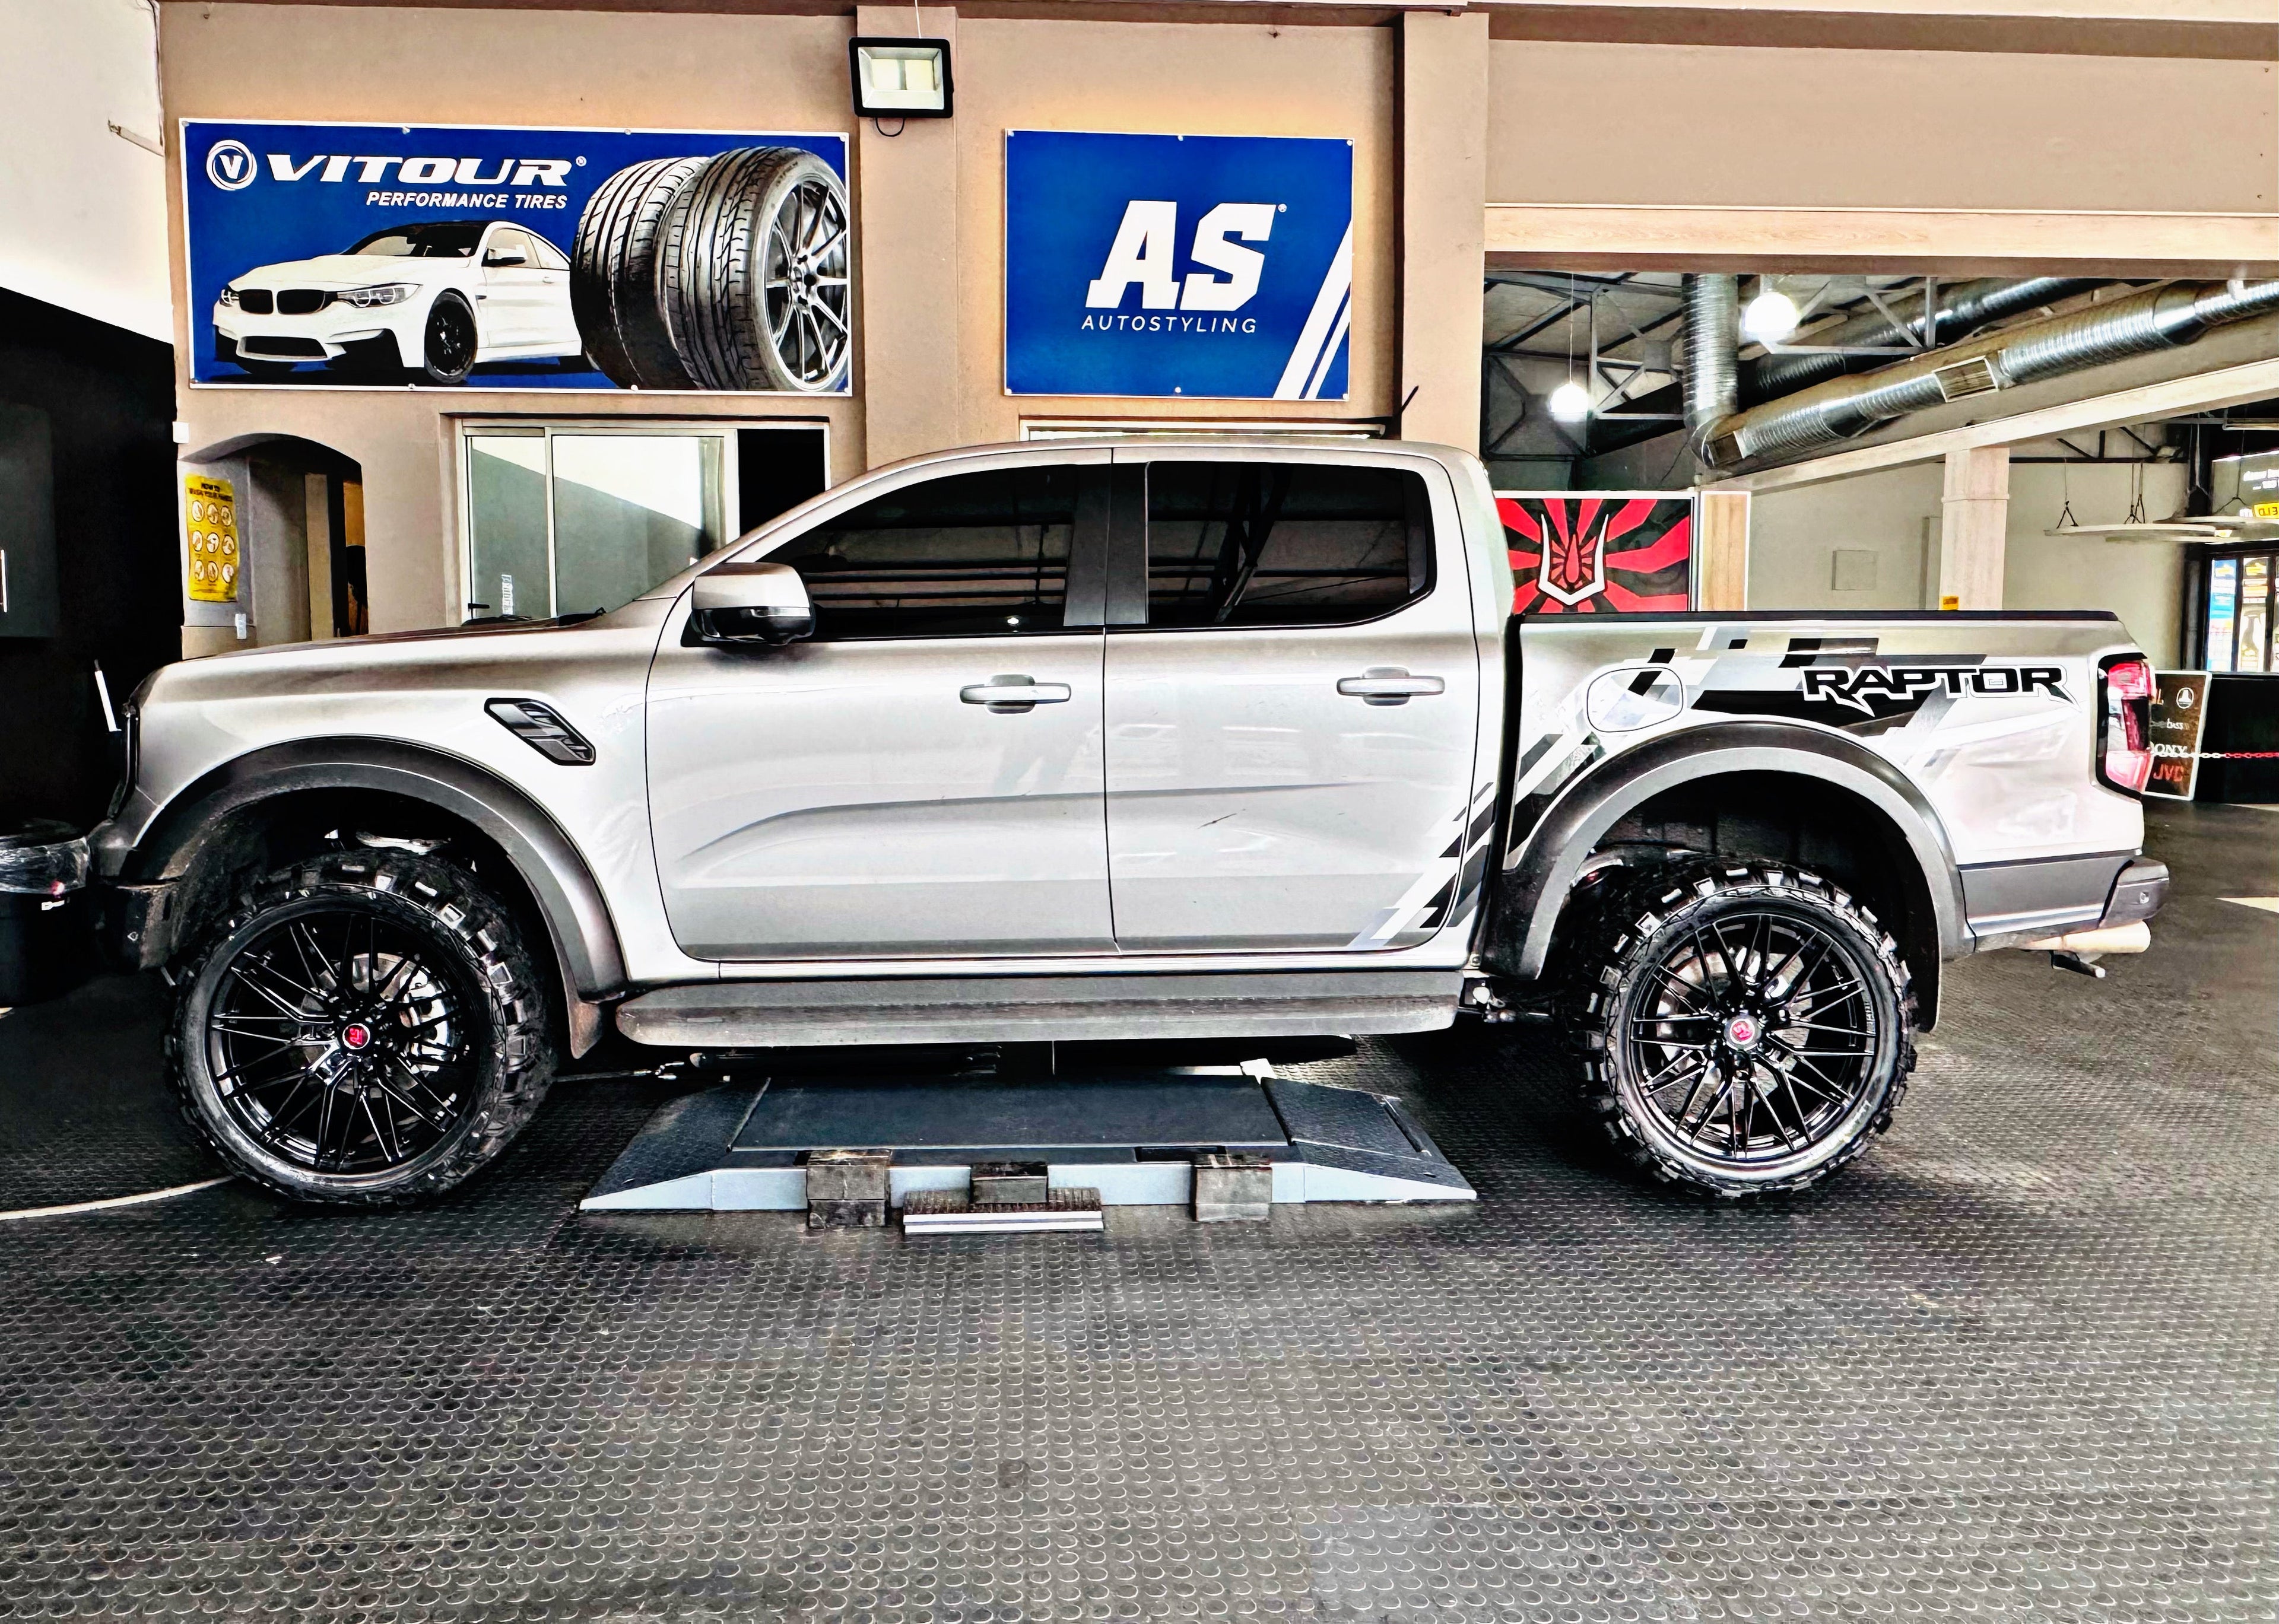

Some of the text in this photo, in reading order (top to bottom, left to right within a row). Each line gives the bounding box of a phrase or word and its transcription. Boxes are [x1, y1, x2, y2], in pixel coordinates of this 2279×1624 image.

[266, 154, 572, 186] VITOUR
[366, 190, 568, 209] PERFORMANCE TIRES
[1085, 200, 1277, 312] AS
[1081, 314, 1257, 333] AUTOSTYLING
[1800, 665, 2080, 716] RAPTOR
[2153, 764, 2185, 782] JVC
